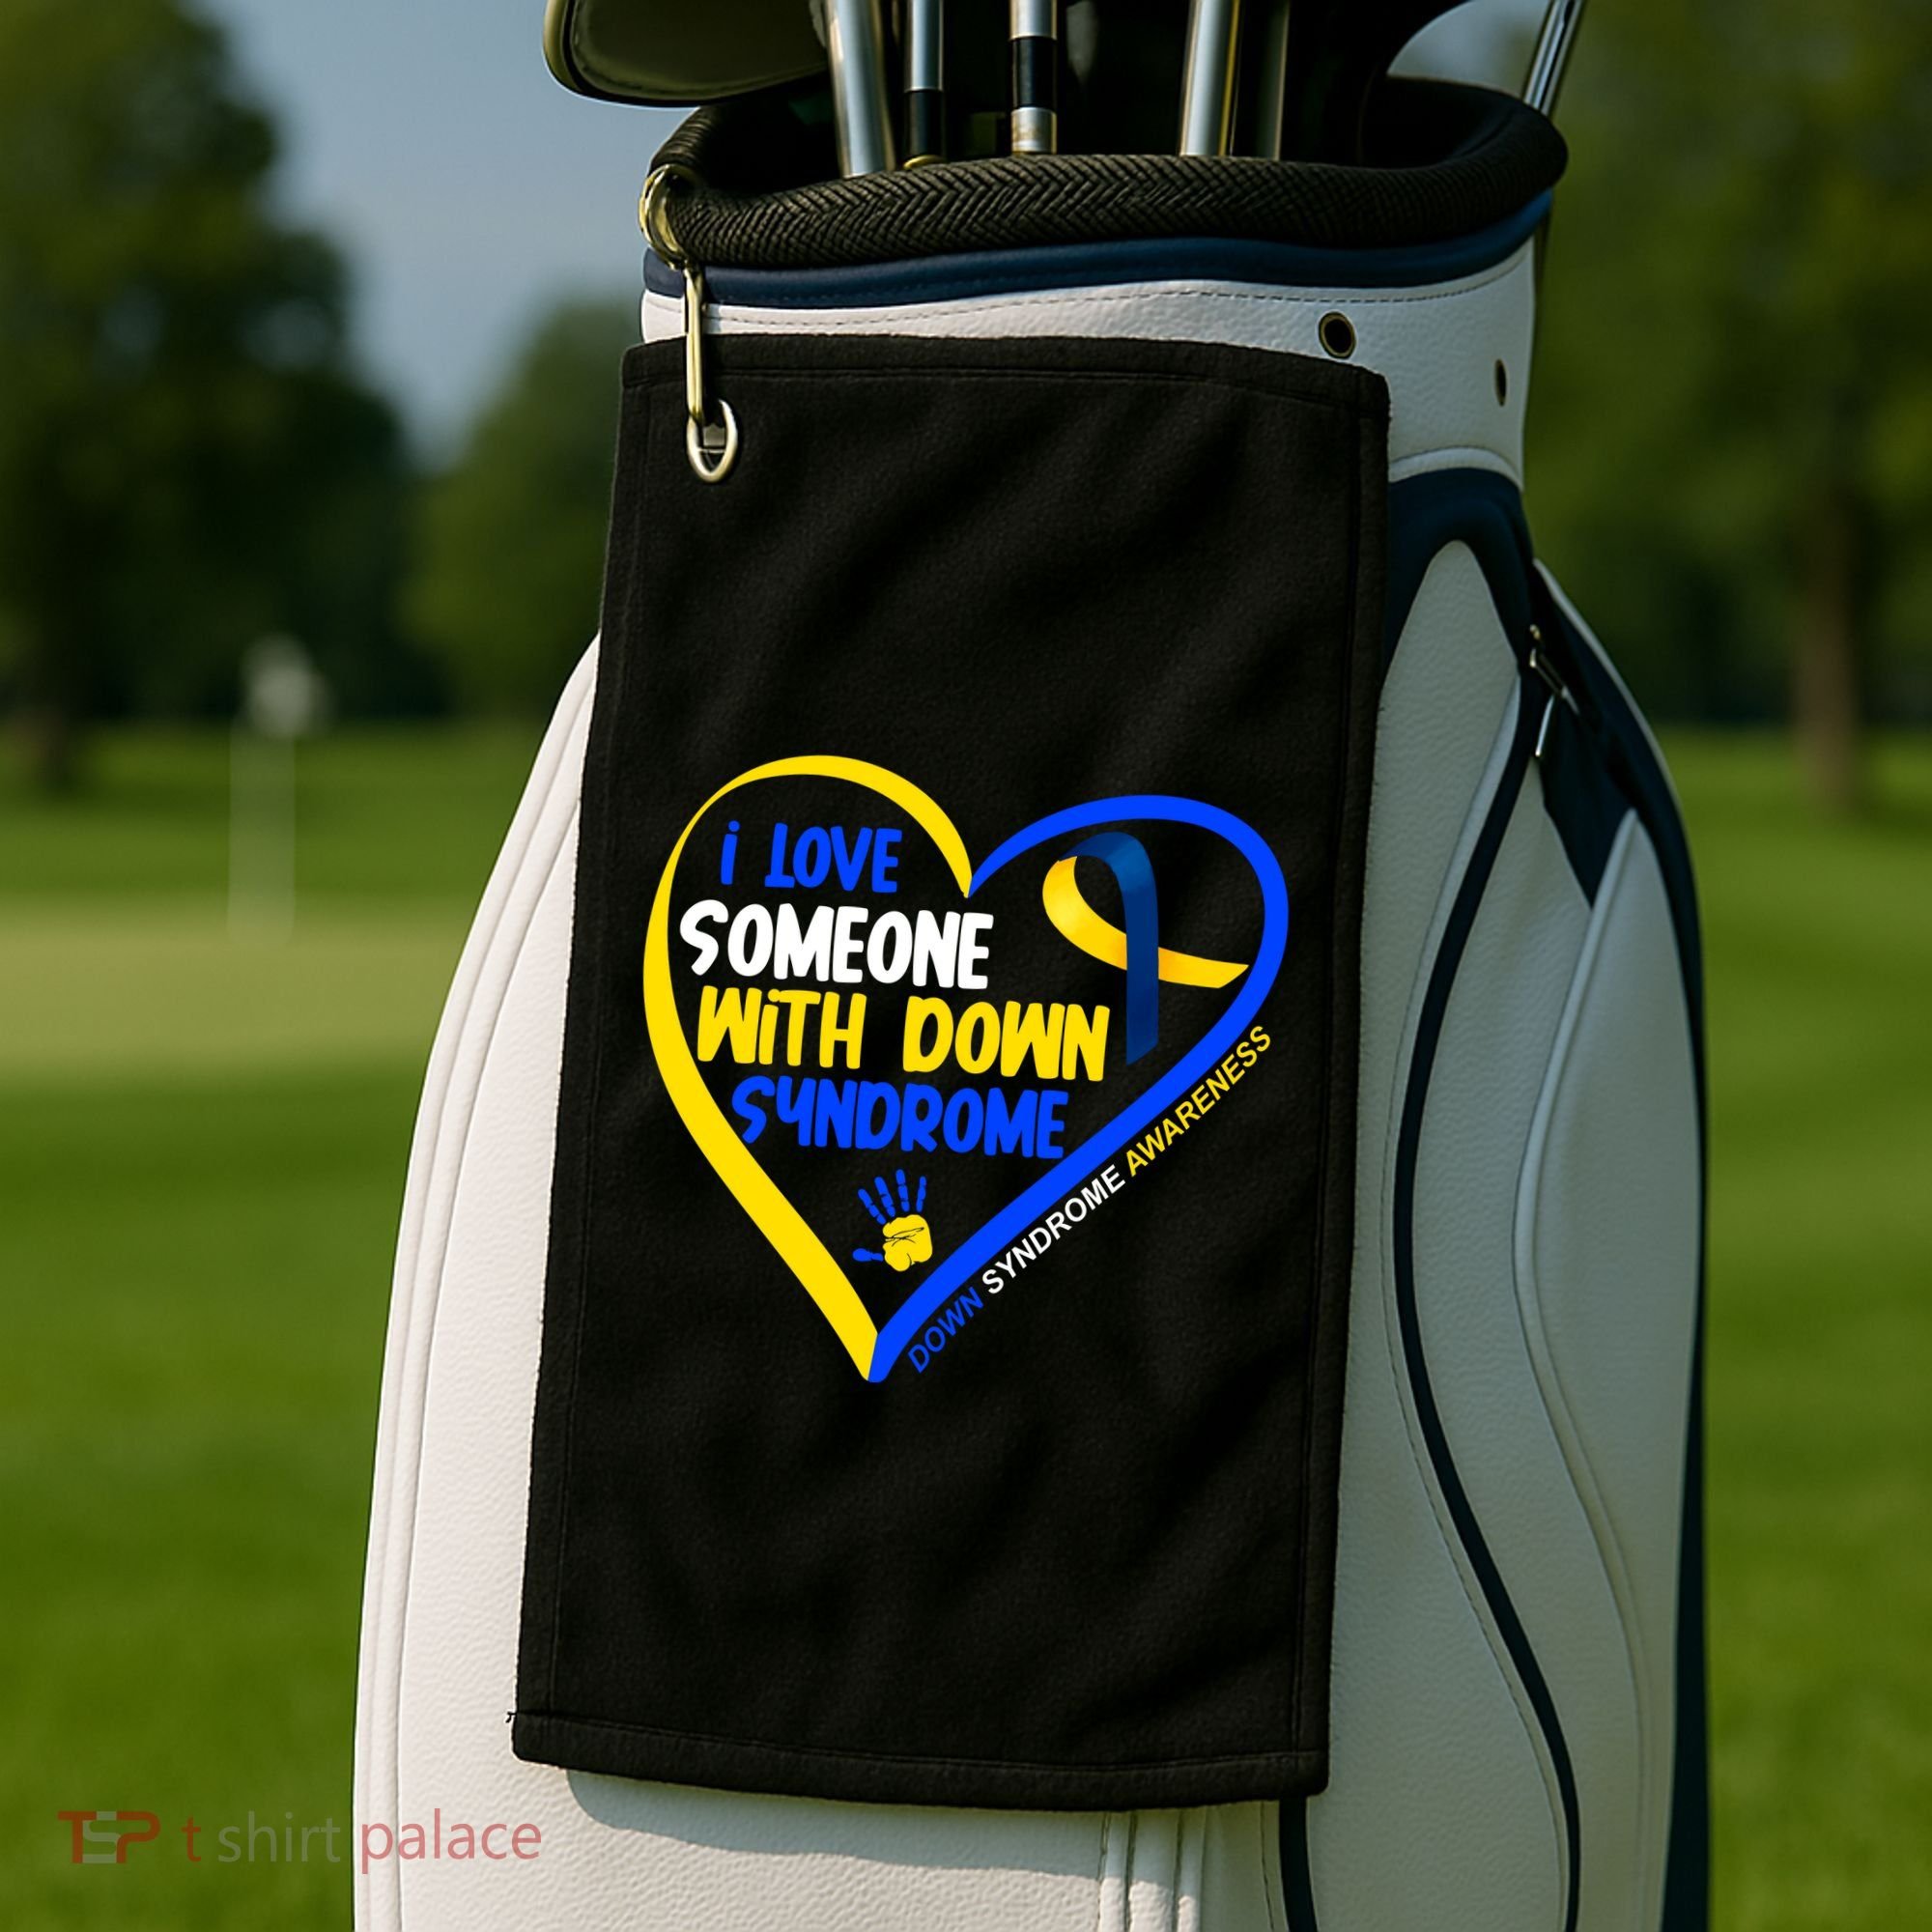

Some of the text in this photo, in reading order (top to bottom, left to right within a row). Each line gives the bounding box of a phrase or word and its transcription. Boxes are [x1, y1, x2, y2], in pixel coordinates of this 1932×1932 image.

[764, 822, 902, 894] LOVE
[679, 899, 994, 989] SOMEONE
[903, 996, 1110, 1081] DOWN
[730, 1075, 1068, 1159] SYNDROME
[908, 1026, 1271, 1373] DOWN SYNDROME AWARENESS
